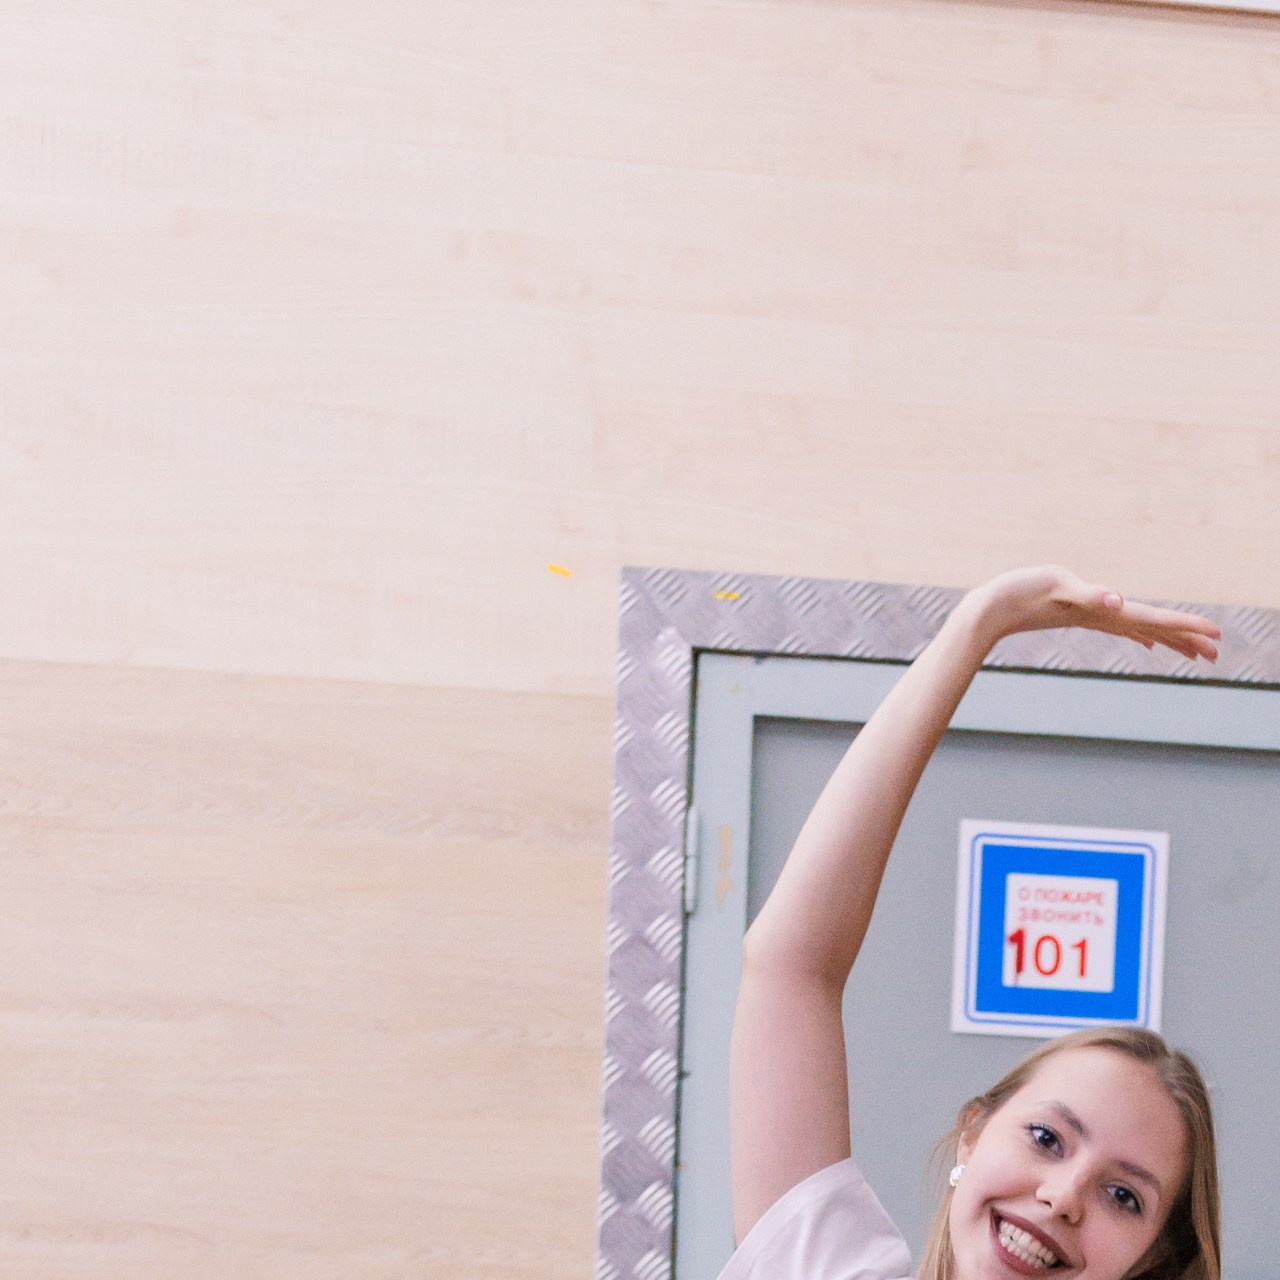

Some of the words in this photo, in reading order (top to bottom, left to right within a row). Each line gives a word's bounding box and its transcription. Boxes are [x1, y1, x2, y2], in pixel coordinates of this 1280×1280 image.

[1018, 887, 1031, 901] О
[1034, 887, 1105, 906] ПОЖАРЕ
[1018, 907, 1104, 926] ЗВОНИТЬ
[1008, 927, 1088, 978] 101
